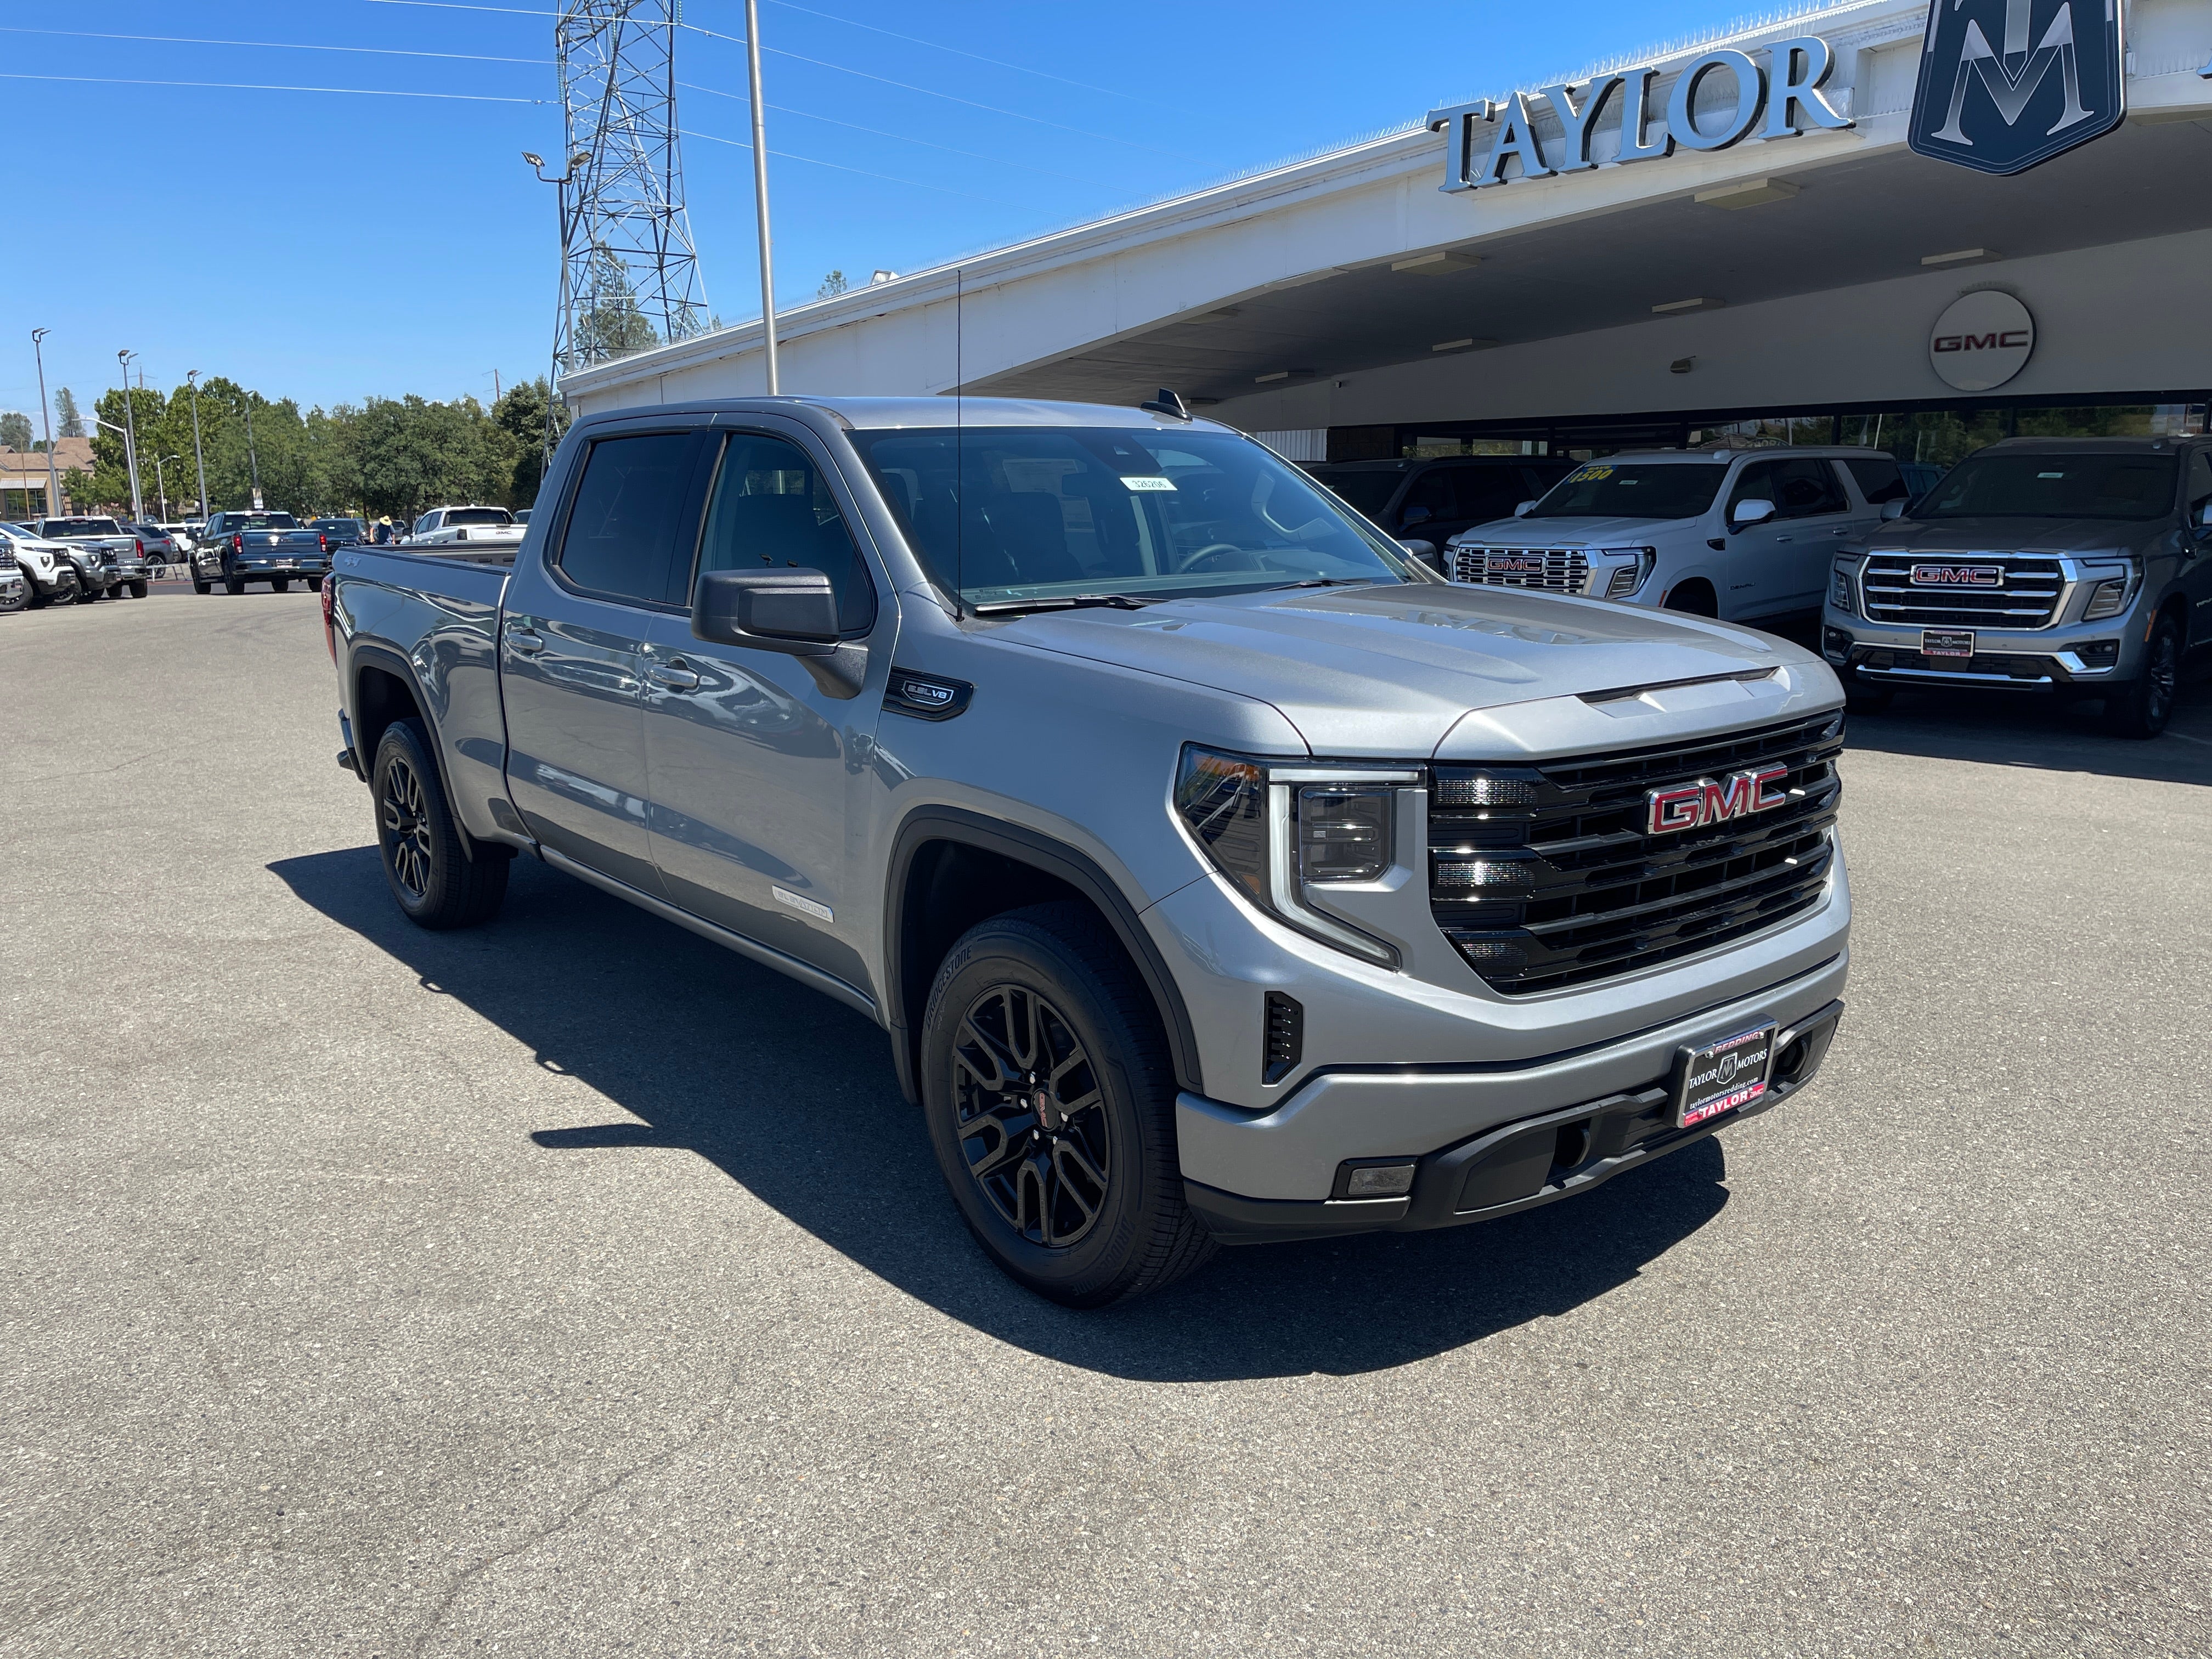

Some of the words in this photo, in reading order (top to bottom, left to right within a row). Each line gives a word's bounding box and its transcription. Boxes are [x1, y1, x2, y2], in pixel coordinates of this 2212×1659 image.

[1426, 36, 1855, 193] TAYLOR
[1934, 330, 2029, 352] GMC
[1132, 480, 1167, 488] 326206
[1488, 558, 1541, 571] GMC
[1916, 567, 1996, 583] GMC
[1646, 761, 1787, 834] GMC
[777, 890, 828, 917] ELEVATION
[1715, 1032, 1759, 1053] REDDING
[1689, 1069, 1717, 1089] TAYLOR
[1737, 1048, 1768, 1070] MOTORS
[1690, 1077, 1758, 1110] taylormotorsredding.com
[1702, 1090, 1748, 1118] TAYLOR
[1039, 1093, 1048, 1127] GMC
